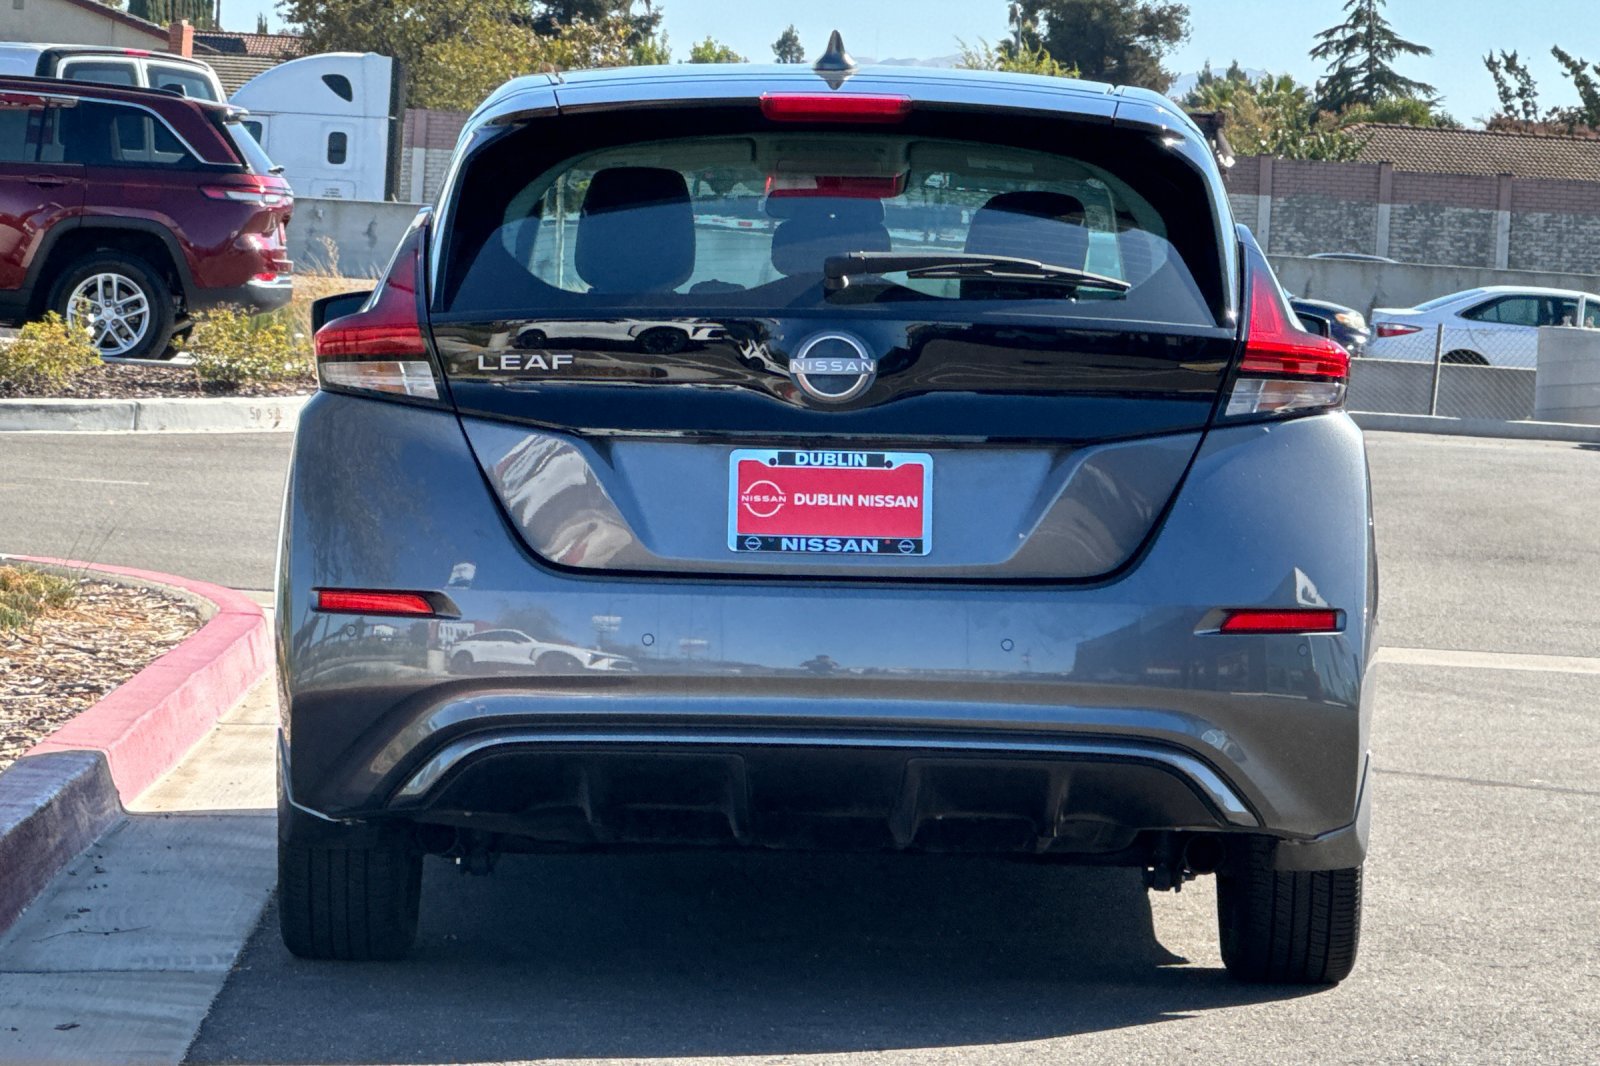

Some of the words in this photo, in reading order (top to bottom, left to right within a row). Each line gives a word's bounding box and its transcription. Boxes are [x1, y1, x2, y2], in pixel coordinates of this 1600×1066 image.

[477, 354, 574, 370] LEAF
[792, 361, 874, 372] NISSAN
[795, 452, 868, 467] DUBLIN
[741, 494, 787, 503] NISSAN
[794, 493, 853, 507] DUBLIN
[858, 496, 918, 508] NISSAN
[781, 537, 879, 552] NISSAN
